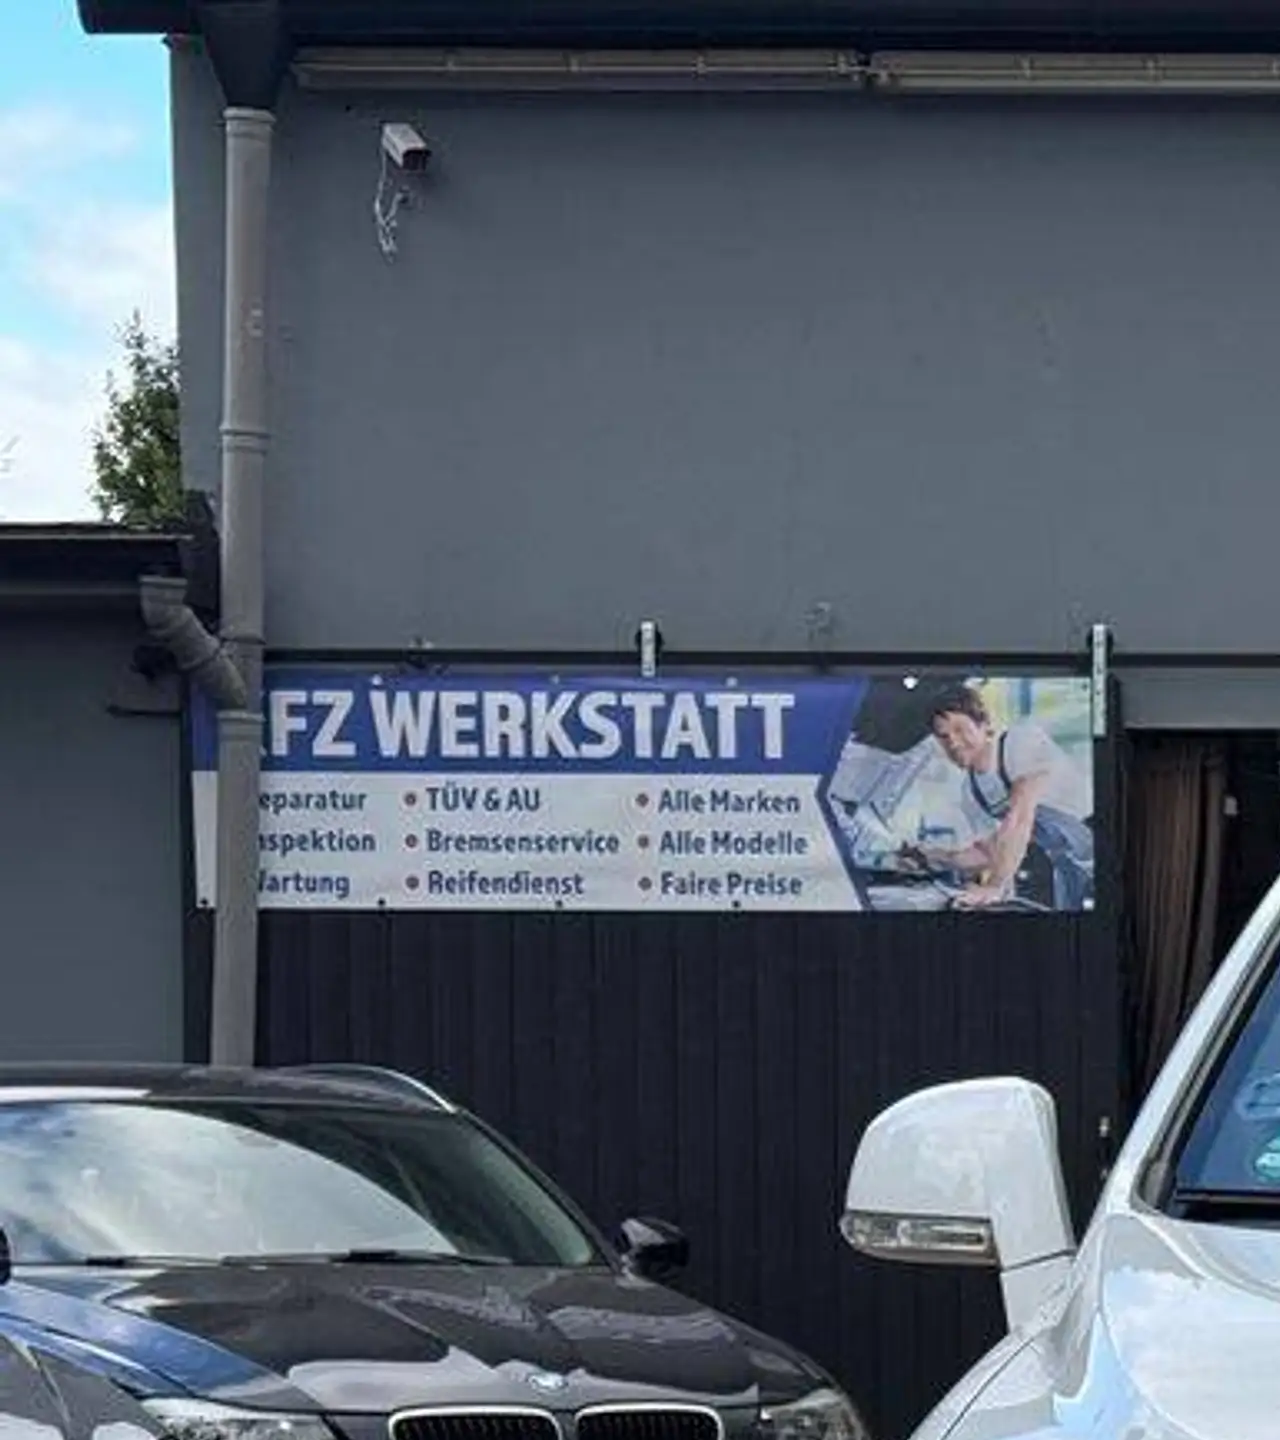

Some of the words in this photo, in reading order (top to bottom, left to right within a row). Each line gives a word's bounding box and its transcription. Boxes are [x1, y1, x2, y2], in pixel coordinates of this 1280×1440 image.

[259, 690, 356, 756] FZ
[369, 690, 795, 759] WERKSTATT
[259, 789, 367, 815] eparatur
[426, 783, 477, 811] TÜV
[484, 789, 501, 811] &
[505, 789, 540, 811] AU
[658, 790, 705, 813] Alle
[710, 790, 799, 813] Marken
[427, 829, 619, 852] Bremsenservice
[660, 831, 706, 854] Alle
[710, 831, 808, 854] Modelle
[428, 870, 584, 894] Reifendienst
[660, 872, 721, 895] Faire
[727, 872, 803, 895] Preise
